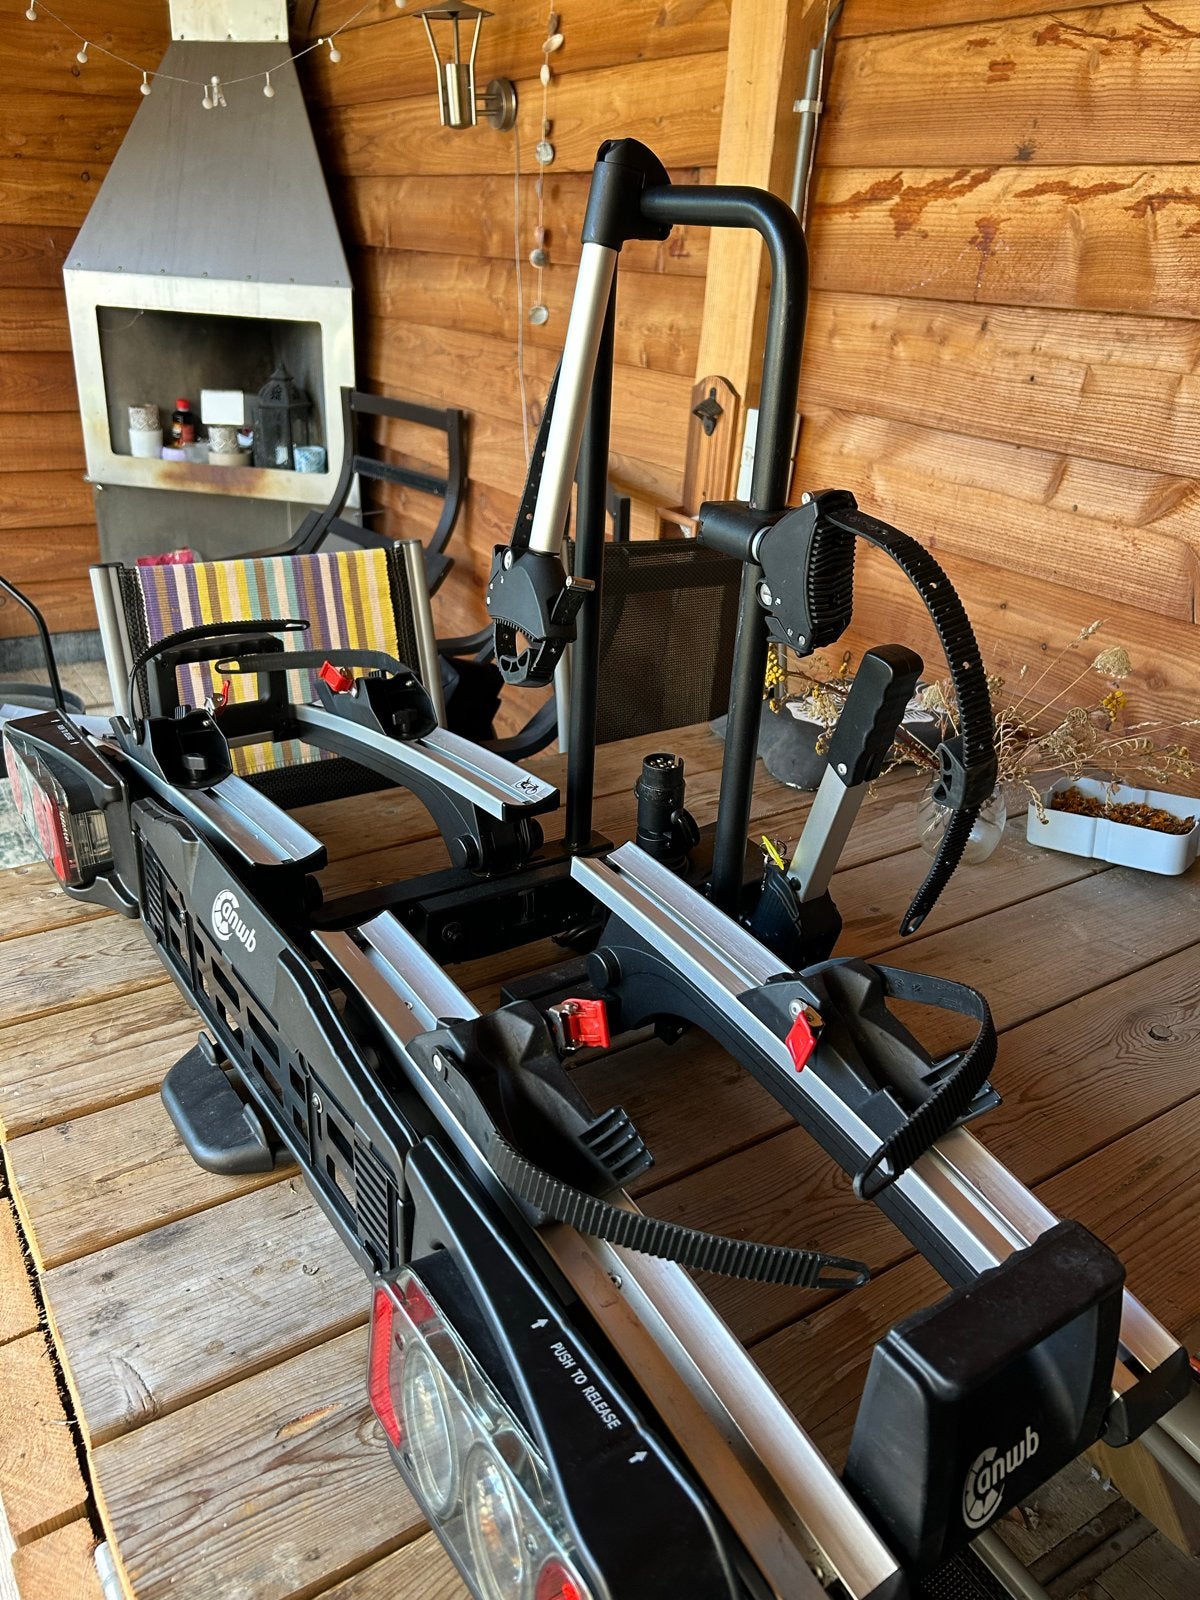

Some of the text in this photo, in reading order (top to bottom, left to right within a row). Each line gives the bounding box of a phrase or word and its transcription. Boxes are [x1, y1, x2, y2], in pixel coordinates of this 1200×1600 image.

[550, 1341, 622, 1430] PUSH TO RELEASE
